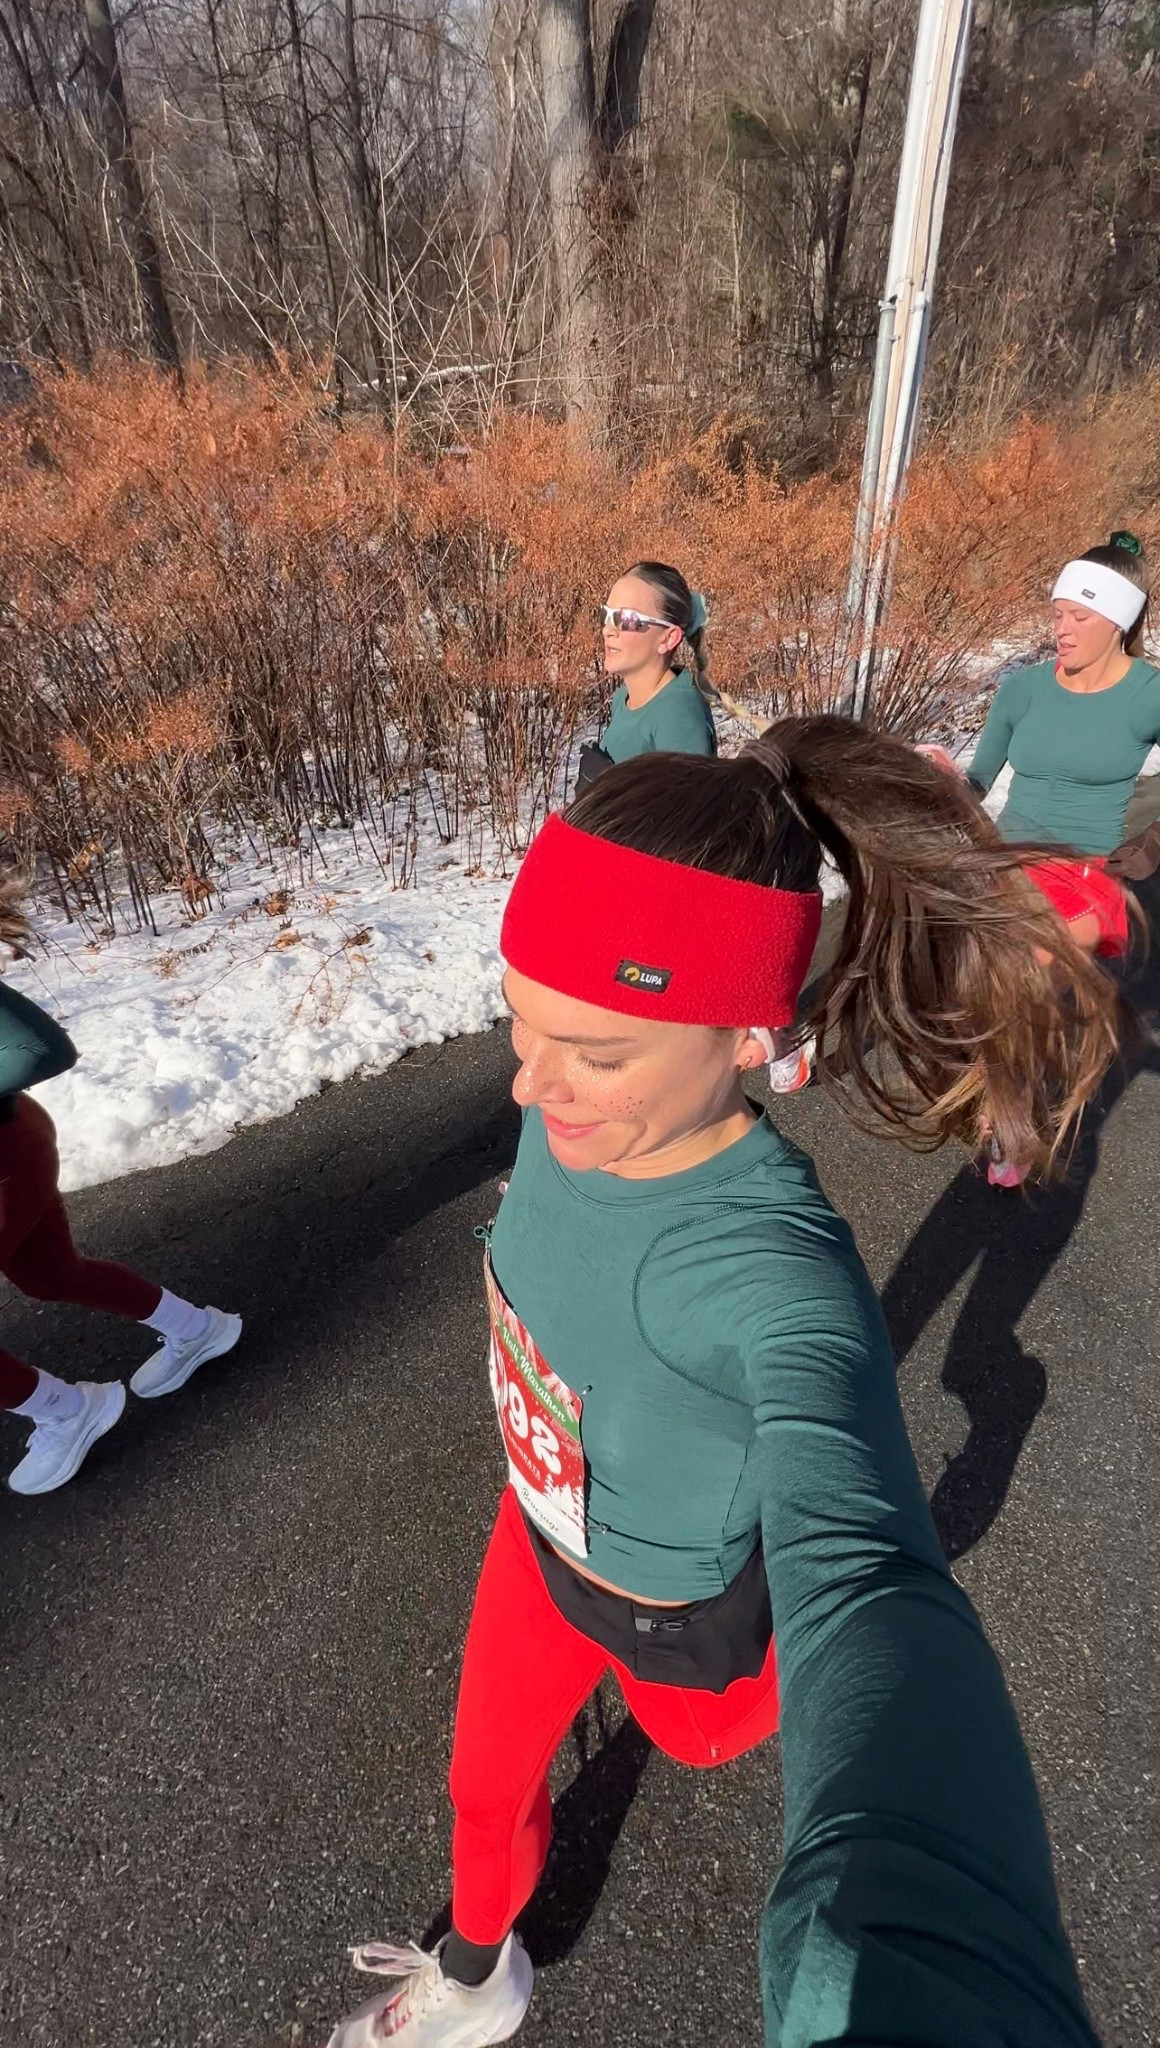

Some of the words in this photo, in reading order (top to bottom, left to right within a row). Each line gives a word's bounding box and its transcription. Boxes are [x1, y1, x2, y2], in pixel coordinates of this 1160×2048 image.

[640, 972, 662, 985] LUPA
[502, 1326, 519, 1358] Half
[519, 1355, 567, 1422] Marathon
